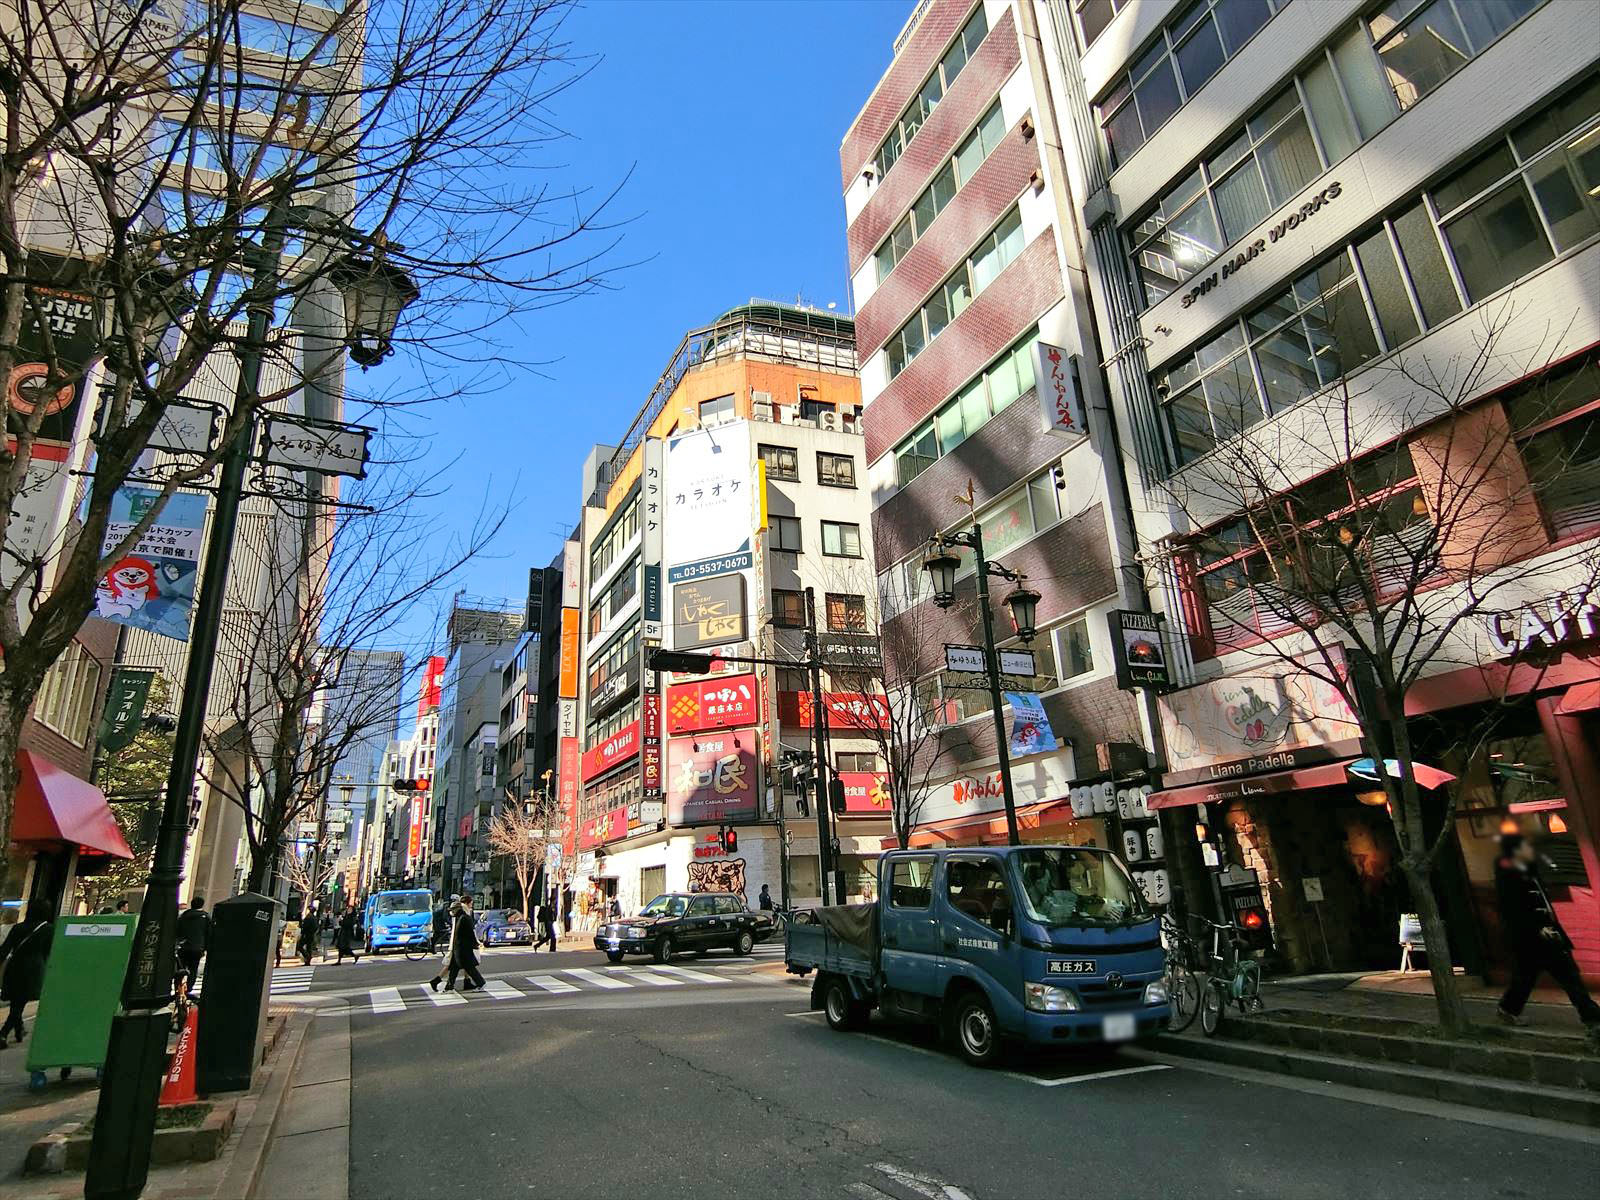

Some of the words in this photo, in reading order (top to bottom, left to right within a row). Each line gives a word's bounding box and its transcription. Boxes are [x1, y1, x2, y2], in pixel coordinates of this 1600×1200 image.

[1181, 272, 1217, 309] SPIN
[1222, 238, 1266, 280] HAIR
[1268, 181, 1342, 244] WORKS
[647, 467, 659, 532] カラオケ
[675, 480, 742, 505] カラオケ
[685, 556, 748, 578] 03-5537-0670
[649, 576, 657, 613] TETSUJIN
[647, 624, 658, 634] 5F
[1122, 613, 1157, 631] PIZZERIA
[703, 684, 751, 703] つぼ八
[563, 704, 573, 737] ダイヤモ
[708, 703, 743, 715] 銀座本店
[645, 753, 659, 777] 和民
[674, 754, 748, 797] 和民
[1210, 763, 1243, 778] Liana
[1248, 753, 1295, 771] Padella
[1104, 787, 1115, 806] はつ
[1127, 837, 1136, 856] 豚串
[1147, 833, 1157, 855] つくね
[138, 920, 160, 987] みゆき通り
[1051, 962, 1094, 972] 高圧ガス
